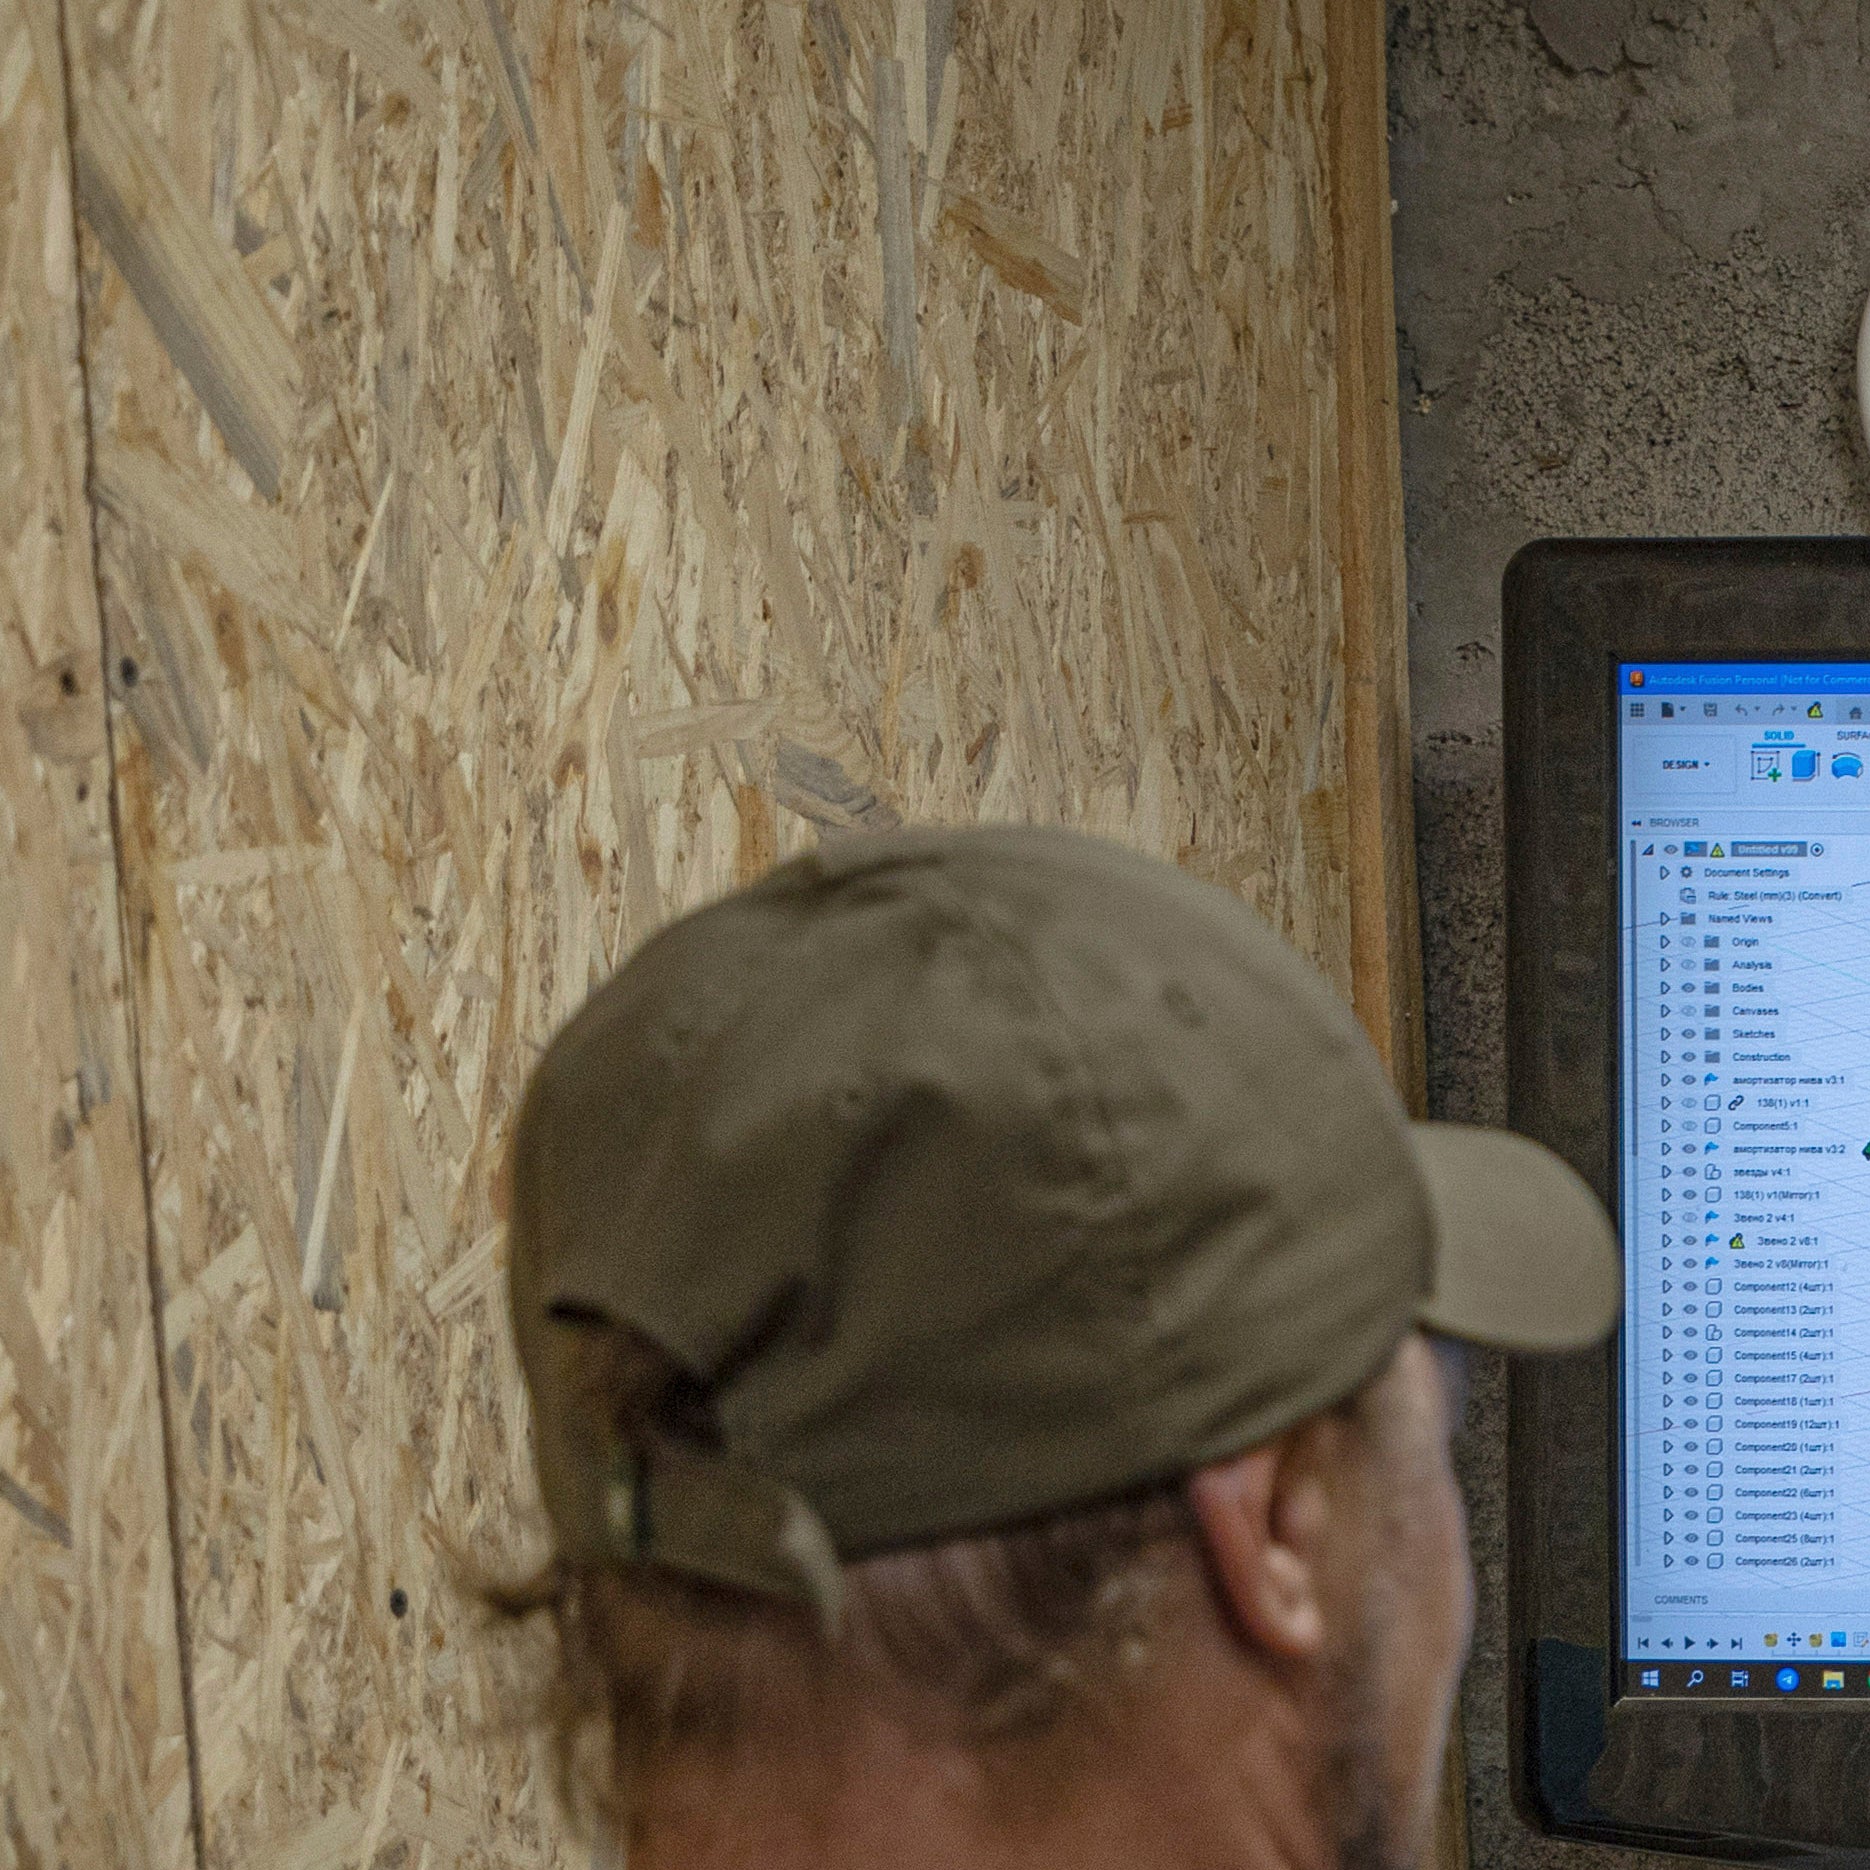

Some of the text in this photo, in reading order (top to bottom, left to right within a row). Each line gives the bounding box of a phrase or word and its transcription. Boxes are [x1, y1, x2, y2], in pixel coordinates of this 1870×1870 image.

[1699, 674, 1732, 686] Fusion
[1735, 674, 1777, 686] Personal
[1804, 674, 1820, 686] for
[1764, 731, 1795, 741] SOLID
[1663, 760, 1699, 770] DESIGN
[1650, 818, 1699, 828] BROWSER
[1704, 868, 1790, 878] Document Settings
[1734, 891, 1758, 900] Steel
[1798, 891, 1842, 902] (Convert)
[1708, 914, 1773, 924] Named Views
[1732, 937, 1760, 948] Origin
[1732, 960, 1772, 971] Analysis
[1733, 984, 1764, 993] Bodies
[1733, 1006, 1779, 1016] Canvases
[1733, 1030, 1775, 1039] Sketches
[1733, 1052, 1791, 1062] Construction
[1734, 1213, 1764, 1222] Звено
[1766, 1213, 1774, 1222] 2
[1758, 1236, 1788, 1246] Звено
[1790, 1236, 1796, 1246] 2
[1734, 1260, 1764, 1268] Звено
[1767, 1260, 1774, 1268] 2
[1654, 1595, 1708, 1606] COMMENTS
